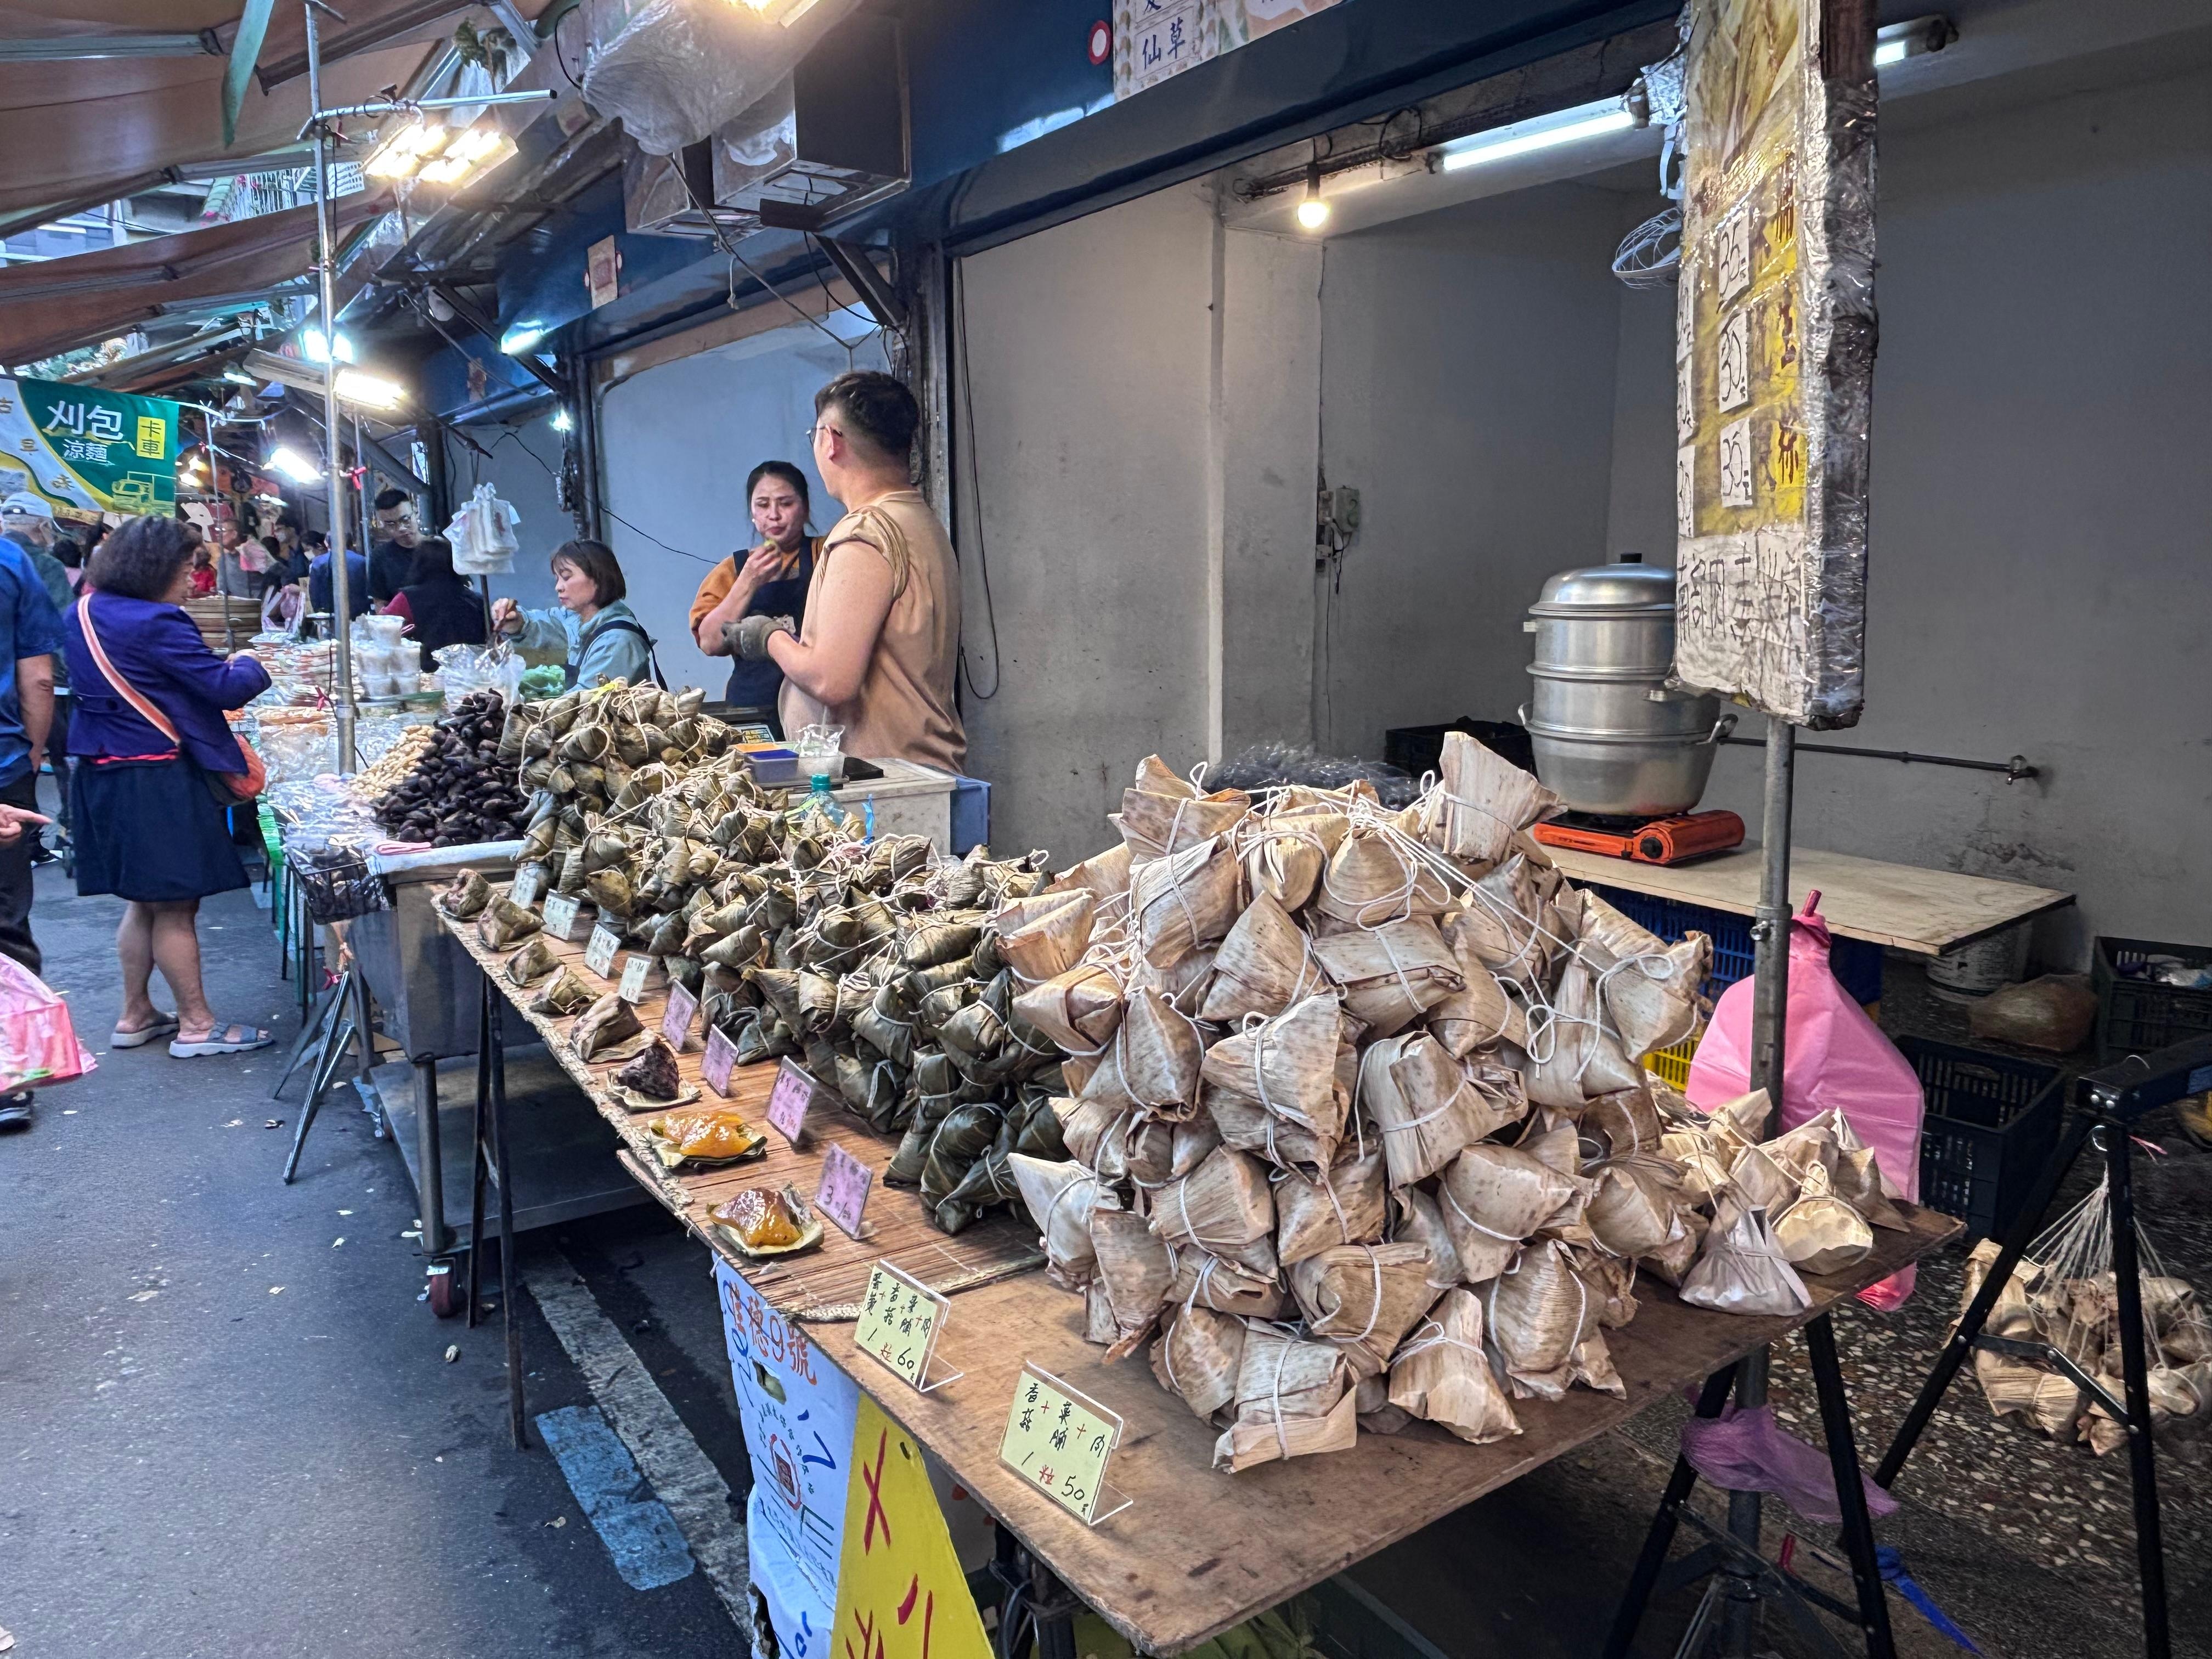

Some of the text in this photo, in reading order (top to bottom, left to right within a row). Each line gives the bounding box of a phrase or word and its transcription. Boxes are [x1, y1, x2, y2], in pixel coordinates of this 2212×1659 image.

[1142, 17, 1185, 70] 仙草
[47, 400, 123, 440] 刈包
[140, 420, 162, 456] 卡車
